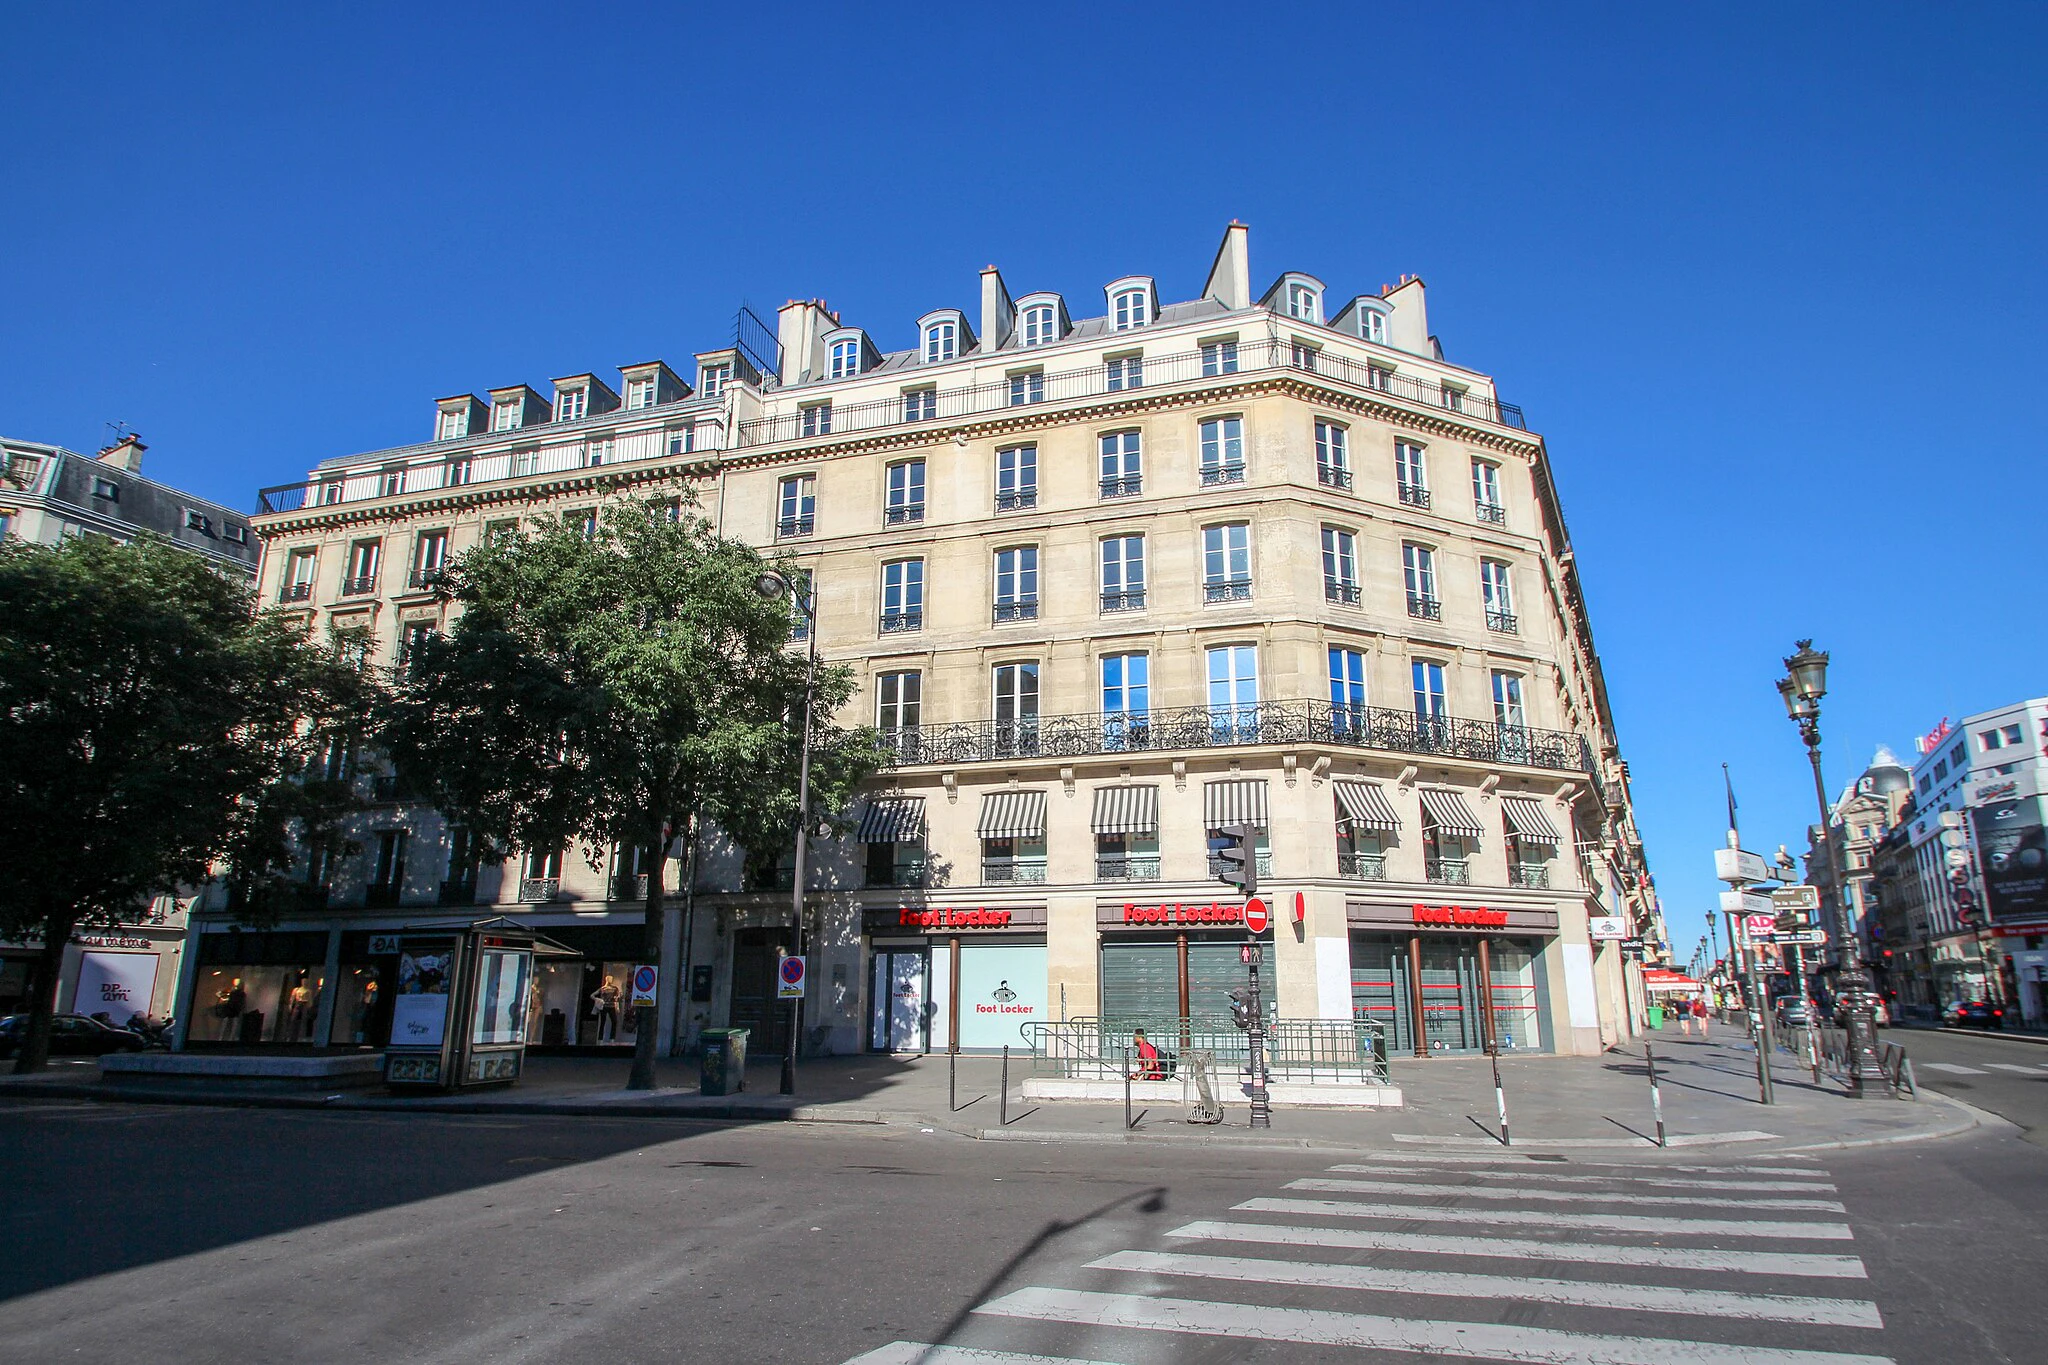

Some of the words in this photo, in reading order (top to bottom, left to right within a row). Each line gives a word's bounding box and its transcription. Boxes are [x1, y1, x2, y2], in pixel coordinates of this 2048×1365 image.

[900, 908, 941, 926] Foot
[945, 907, 1011, 926] Locker
[1123, 903, 1169, 922] Foot
[1175, 902, 1244, 922] Locker
[1412, 904, 1451, 923] Foot
[1452, 905, 1508, 925] Locker
[976, 1004, 997, 1014] Foot
[1000, 1004, 1034, 1014] Locker
